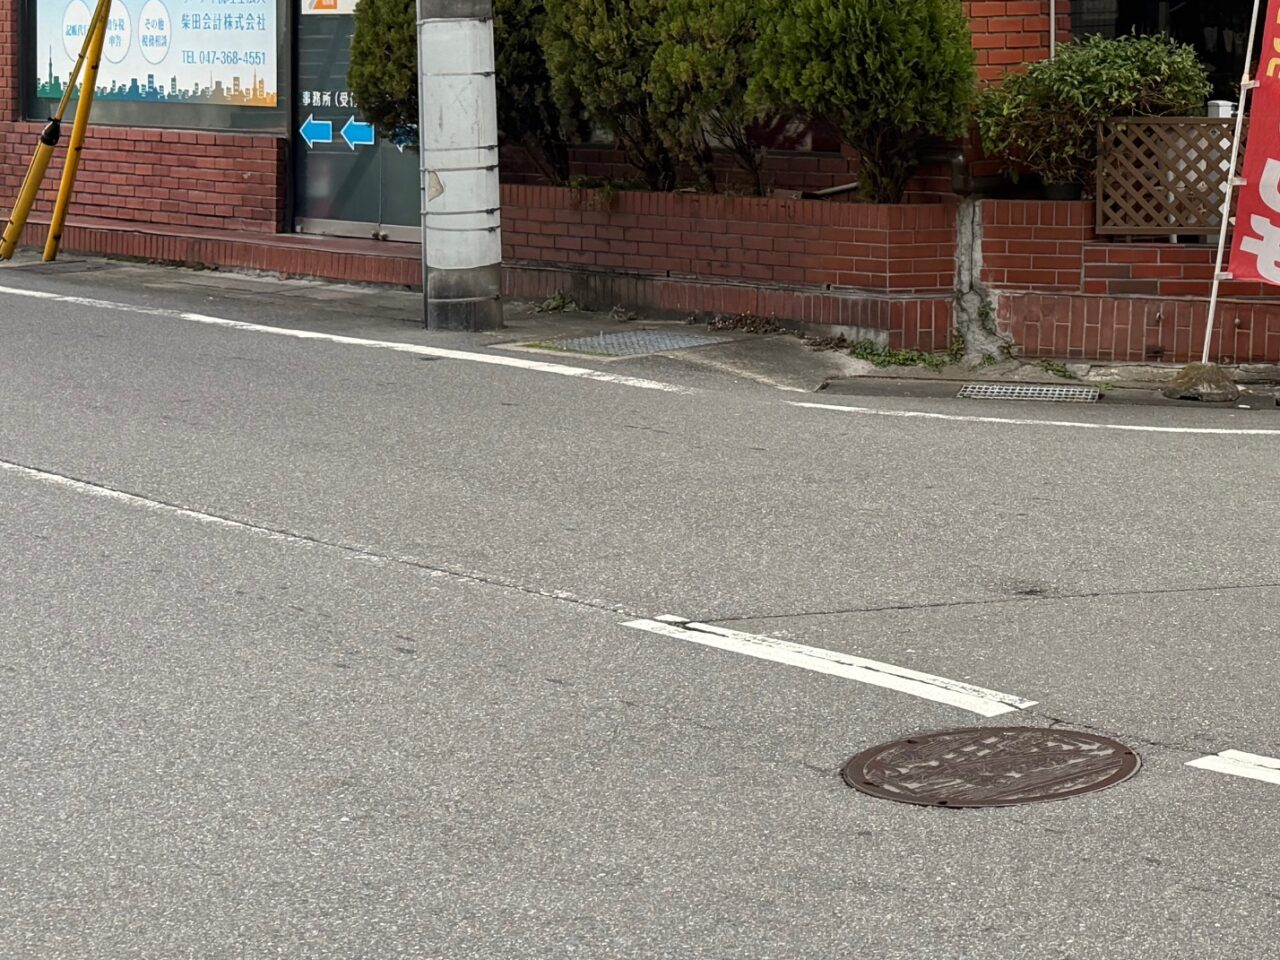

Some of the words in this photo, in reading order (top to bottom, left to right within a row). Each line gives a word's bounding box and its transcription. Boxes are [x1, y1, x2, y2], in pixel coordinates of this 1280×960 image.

[144, 18, 165, 31] その他
[181, 12, 266, 31] 柴田会計株式会社
[182, 50, 197, 64] TEL
[199, 50, 266, 65] 047-368-4551
